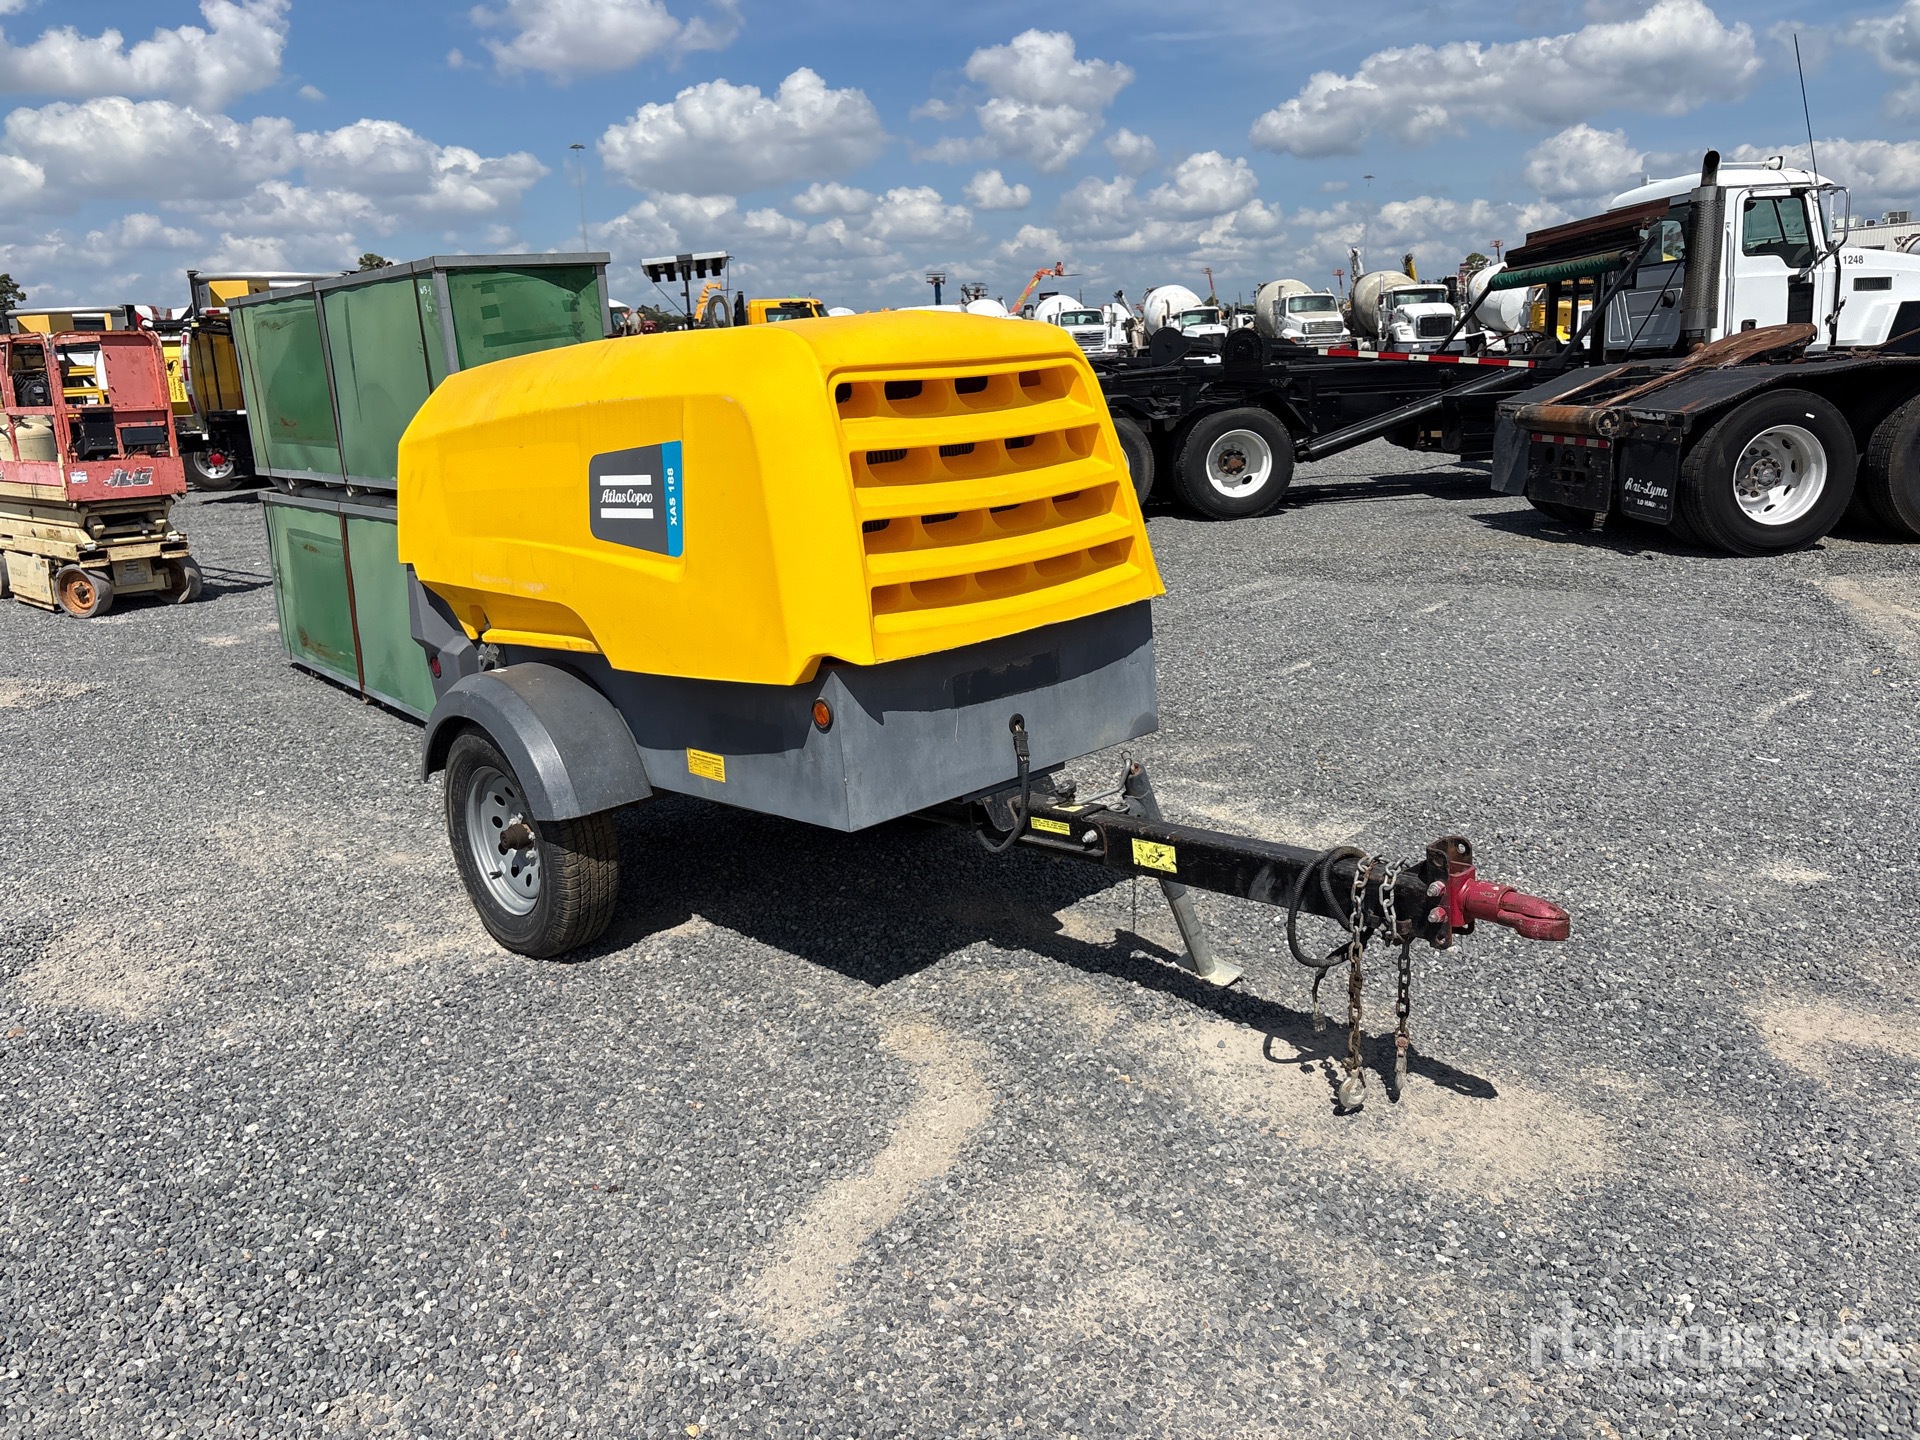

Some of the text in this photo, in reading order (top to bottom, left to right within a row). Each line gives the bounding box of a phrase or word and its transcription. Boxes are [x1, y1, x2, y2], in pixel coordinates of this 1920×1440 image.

[1843, 255, 1863, 264] 1248
[104, 466, 154, 488] JLG
[667, 467, 678, 526] XAS 188
